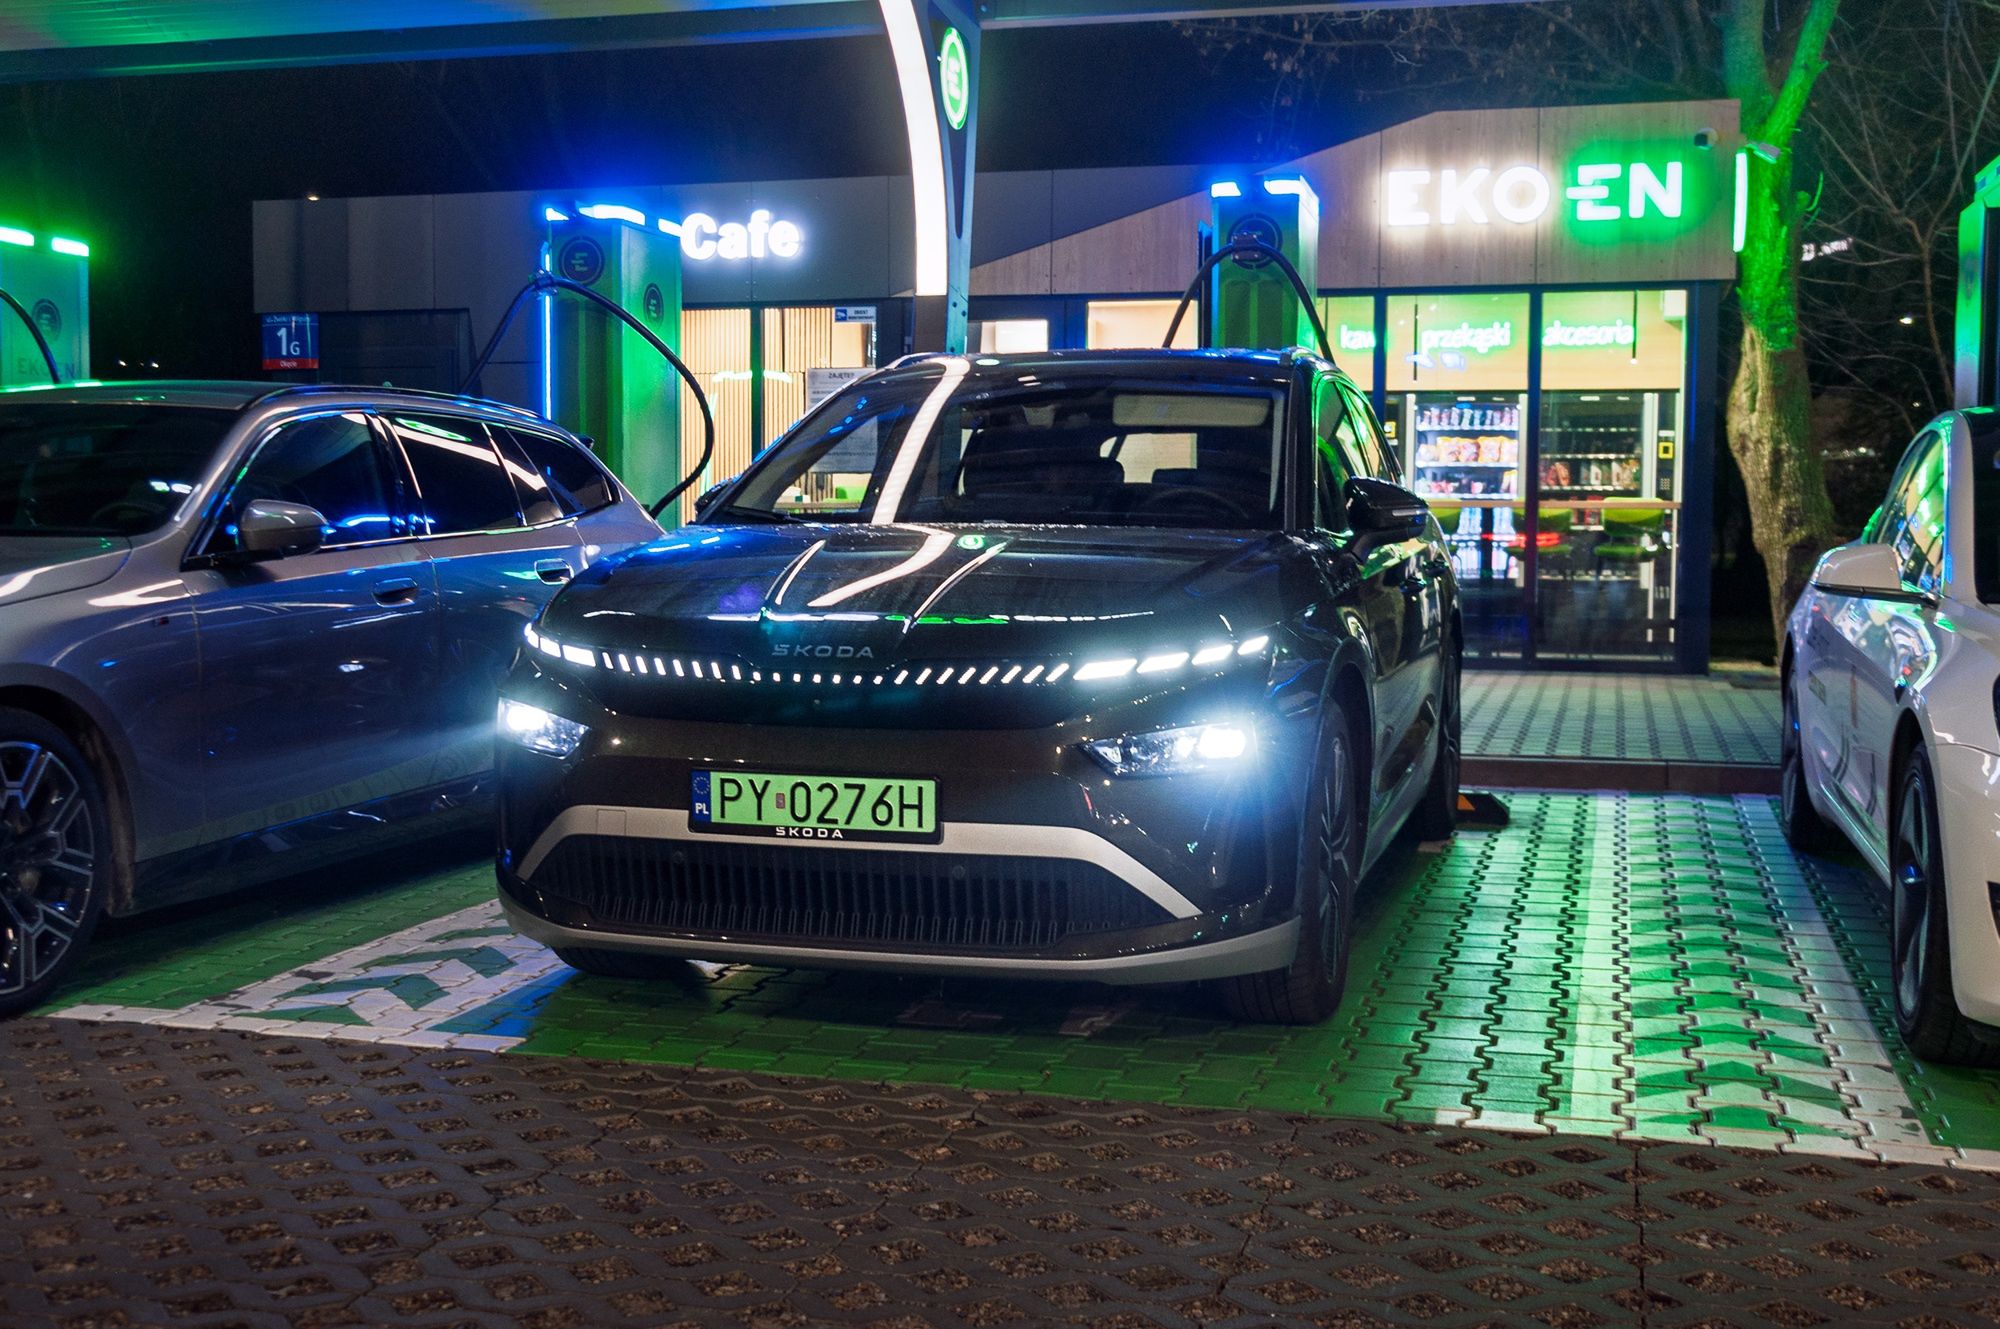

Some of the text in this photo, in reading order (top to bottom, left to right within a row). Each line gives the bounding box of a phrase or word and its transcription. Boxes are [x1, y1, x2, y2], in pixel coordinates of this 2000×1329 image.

[680, 209, 801, 260] Cafe
[1542, 320, 1635, 347] akcesoria
[695, 802, 709, 815] PL
[719, 777, 924, 829] PY 0276H
